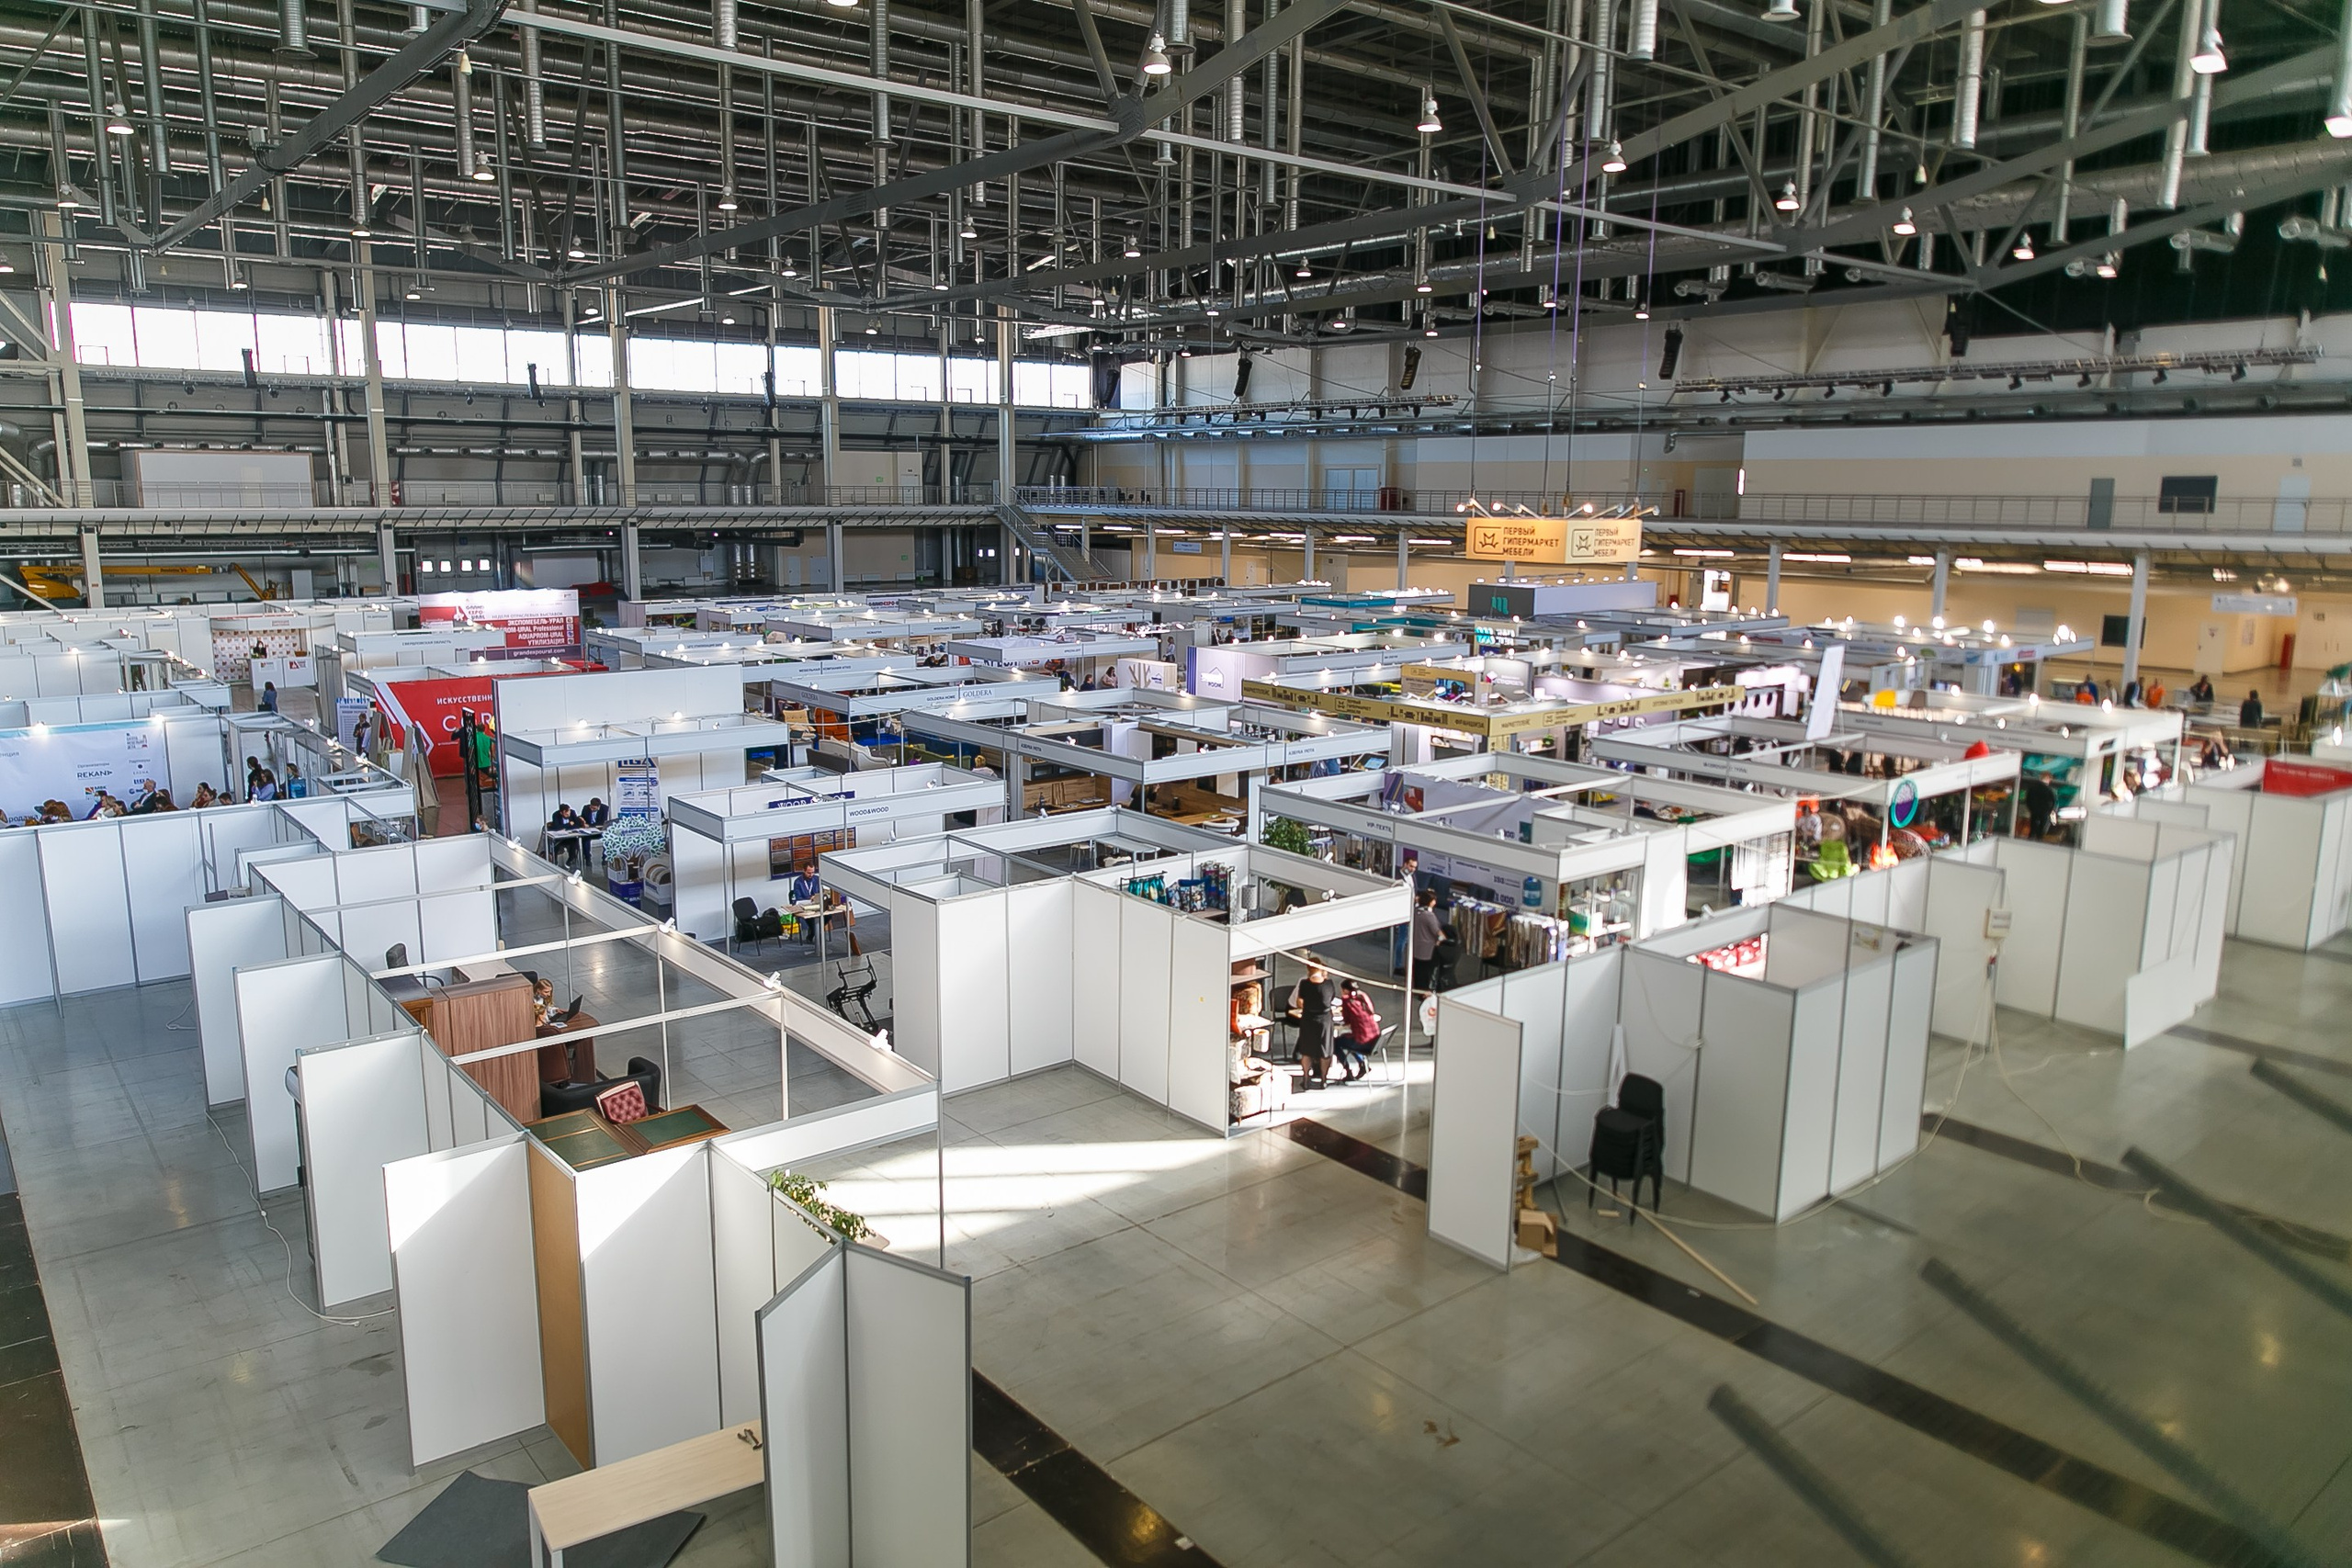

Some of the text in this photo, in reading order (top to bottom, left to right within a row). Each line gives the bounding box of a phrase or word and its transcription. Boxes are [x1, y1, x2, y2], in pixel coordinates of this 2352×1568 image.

[1503, 525, 1535, 536] ПЕРВЫЙ
[1594, 527, 1619, 536] ПЕРВЫЙ
[1502, 537, 1559, 547] ГИПЕРМАРКЕТ
[1594, 537, 1635, 547] ГИПЕРМАРКЕТ
[1502, 547, 1534, 557] МЕБЕЛИ
[1593, 548, 1617, 557] МЕБЕЛИ
[508, 617, 564, 626] ЭКСПОМЕБЕЛЬ-УРАЛ
[518, 631, 564, 640] AQUAPROM-URAL
[527, 638, 565, 647] УТИЛИЗАЦИЯ
[513, 649, 566, 657] grandexpoural.com
[963, 689, 992, 698] GOLDERA
[849, 807, 889, 817] WOOD&WOOD
